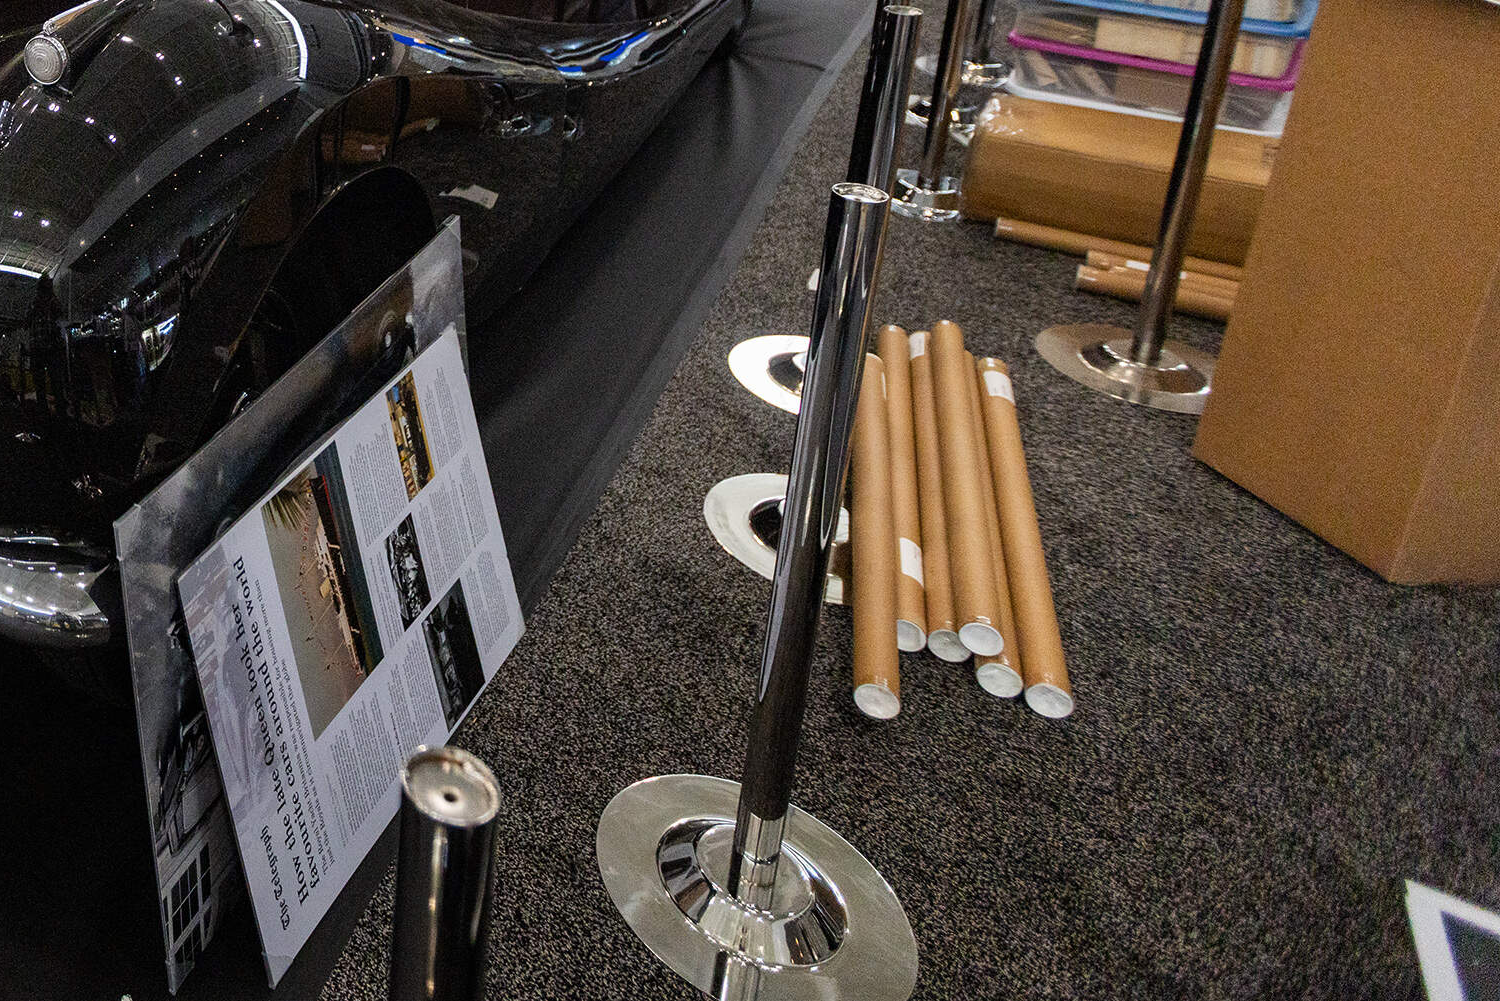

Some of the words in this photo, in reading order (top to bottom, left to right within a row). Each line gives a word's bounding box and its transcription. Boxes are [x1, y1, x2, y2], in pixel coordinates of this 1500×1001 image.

[233, 556, 254, 616] world
[231, 604, 246, 643] her
[251, 621, 264, 658] the
[240, 643, 258, 693] took
[257, 661, 283, 744] around
[254, 695, 275, 766] Queen
[279, 741, 295, 787] cars
[272, 768, 286, 814] late
[283, 813, 296, 850] the
[292, 792, 320, 893] favourite
[260, 825, 283, 901] Telegraph
[292, 856, 309, 905] How
[279, 899, 290, 931] The
